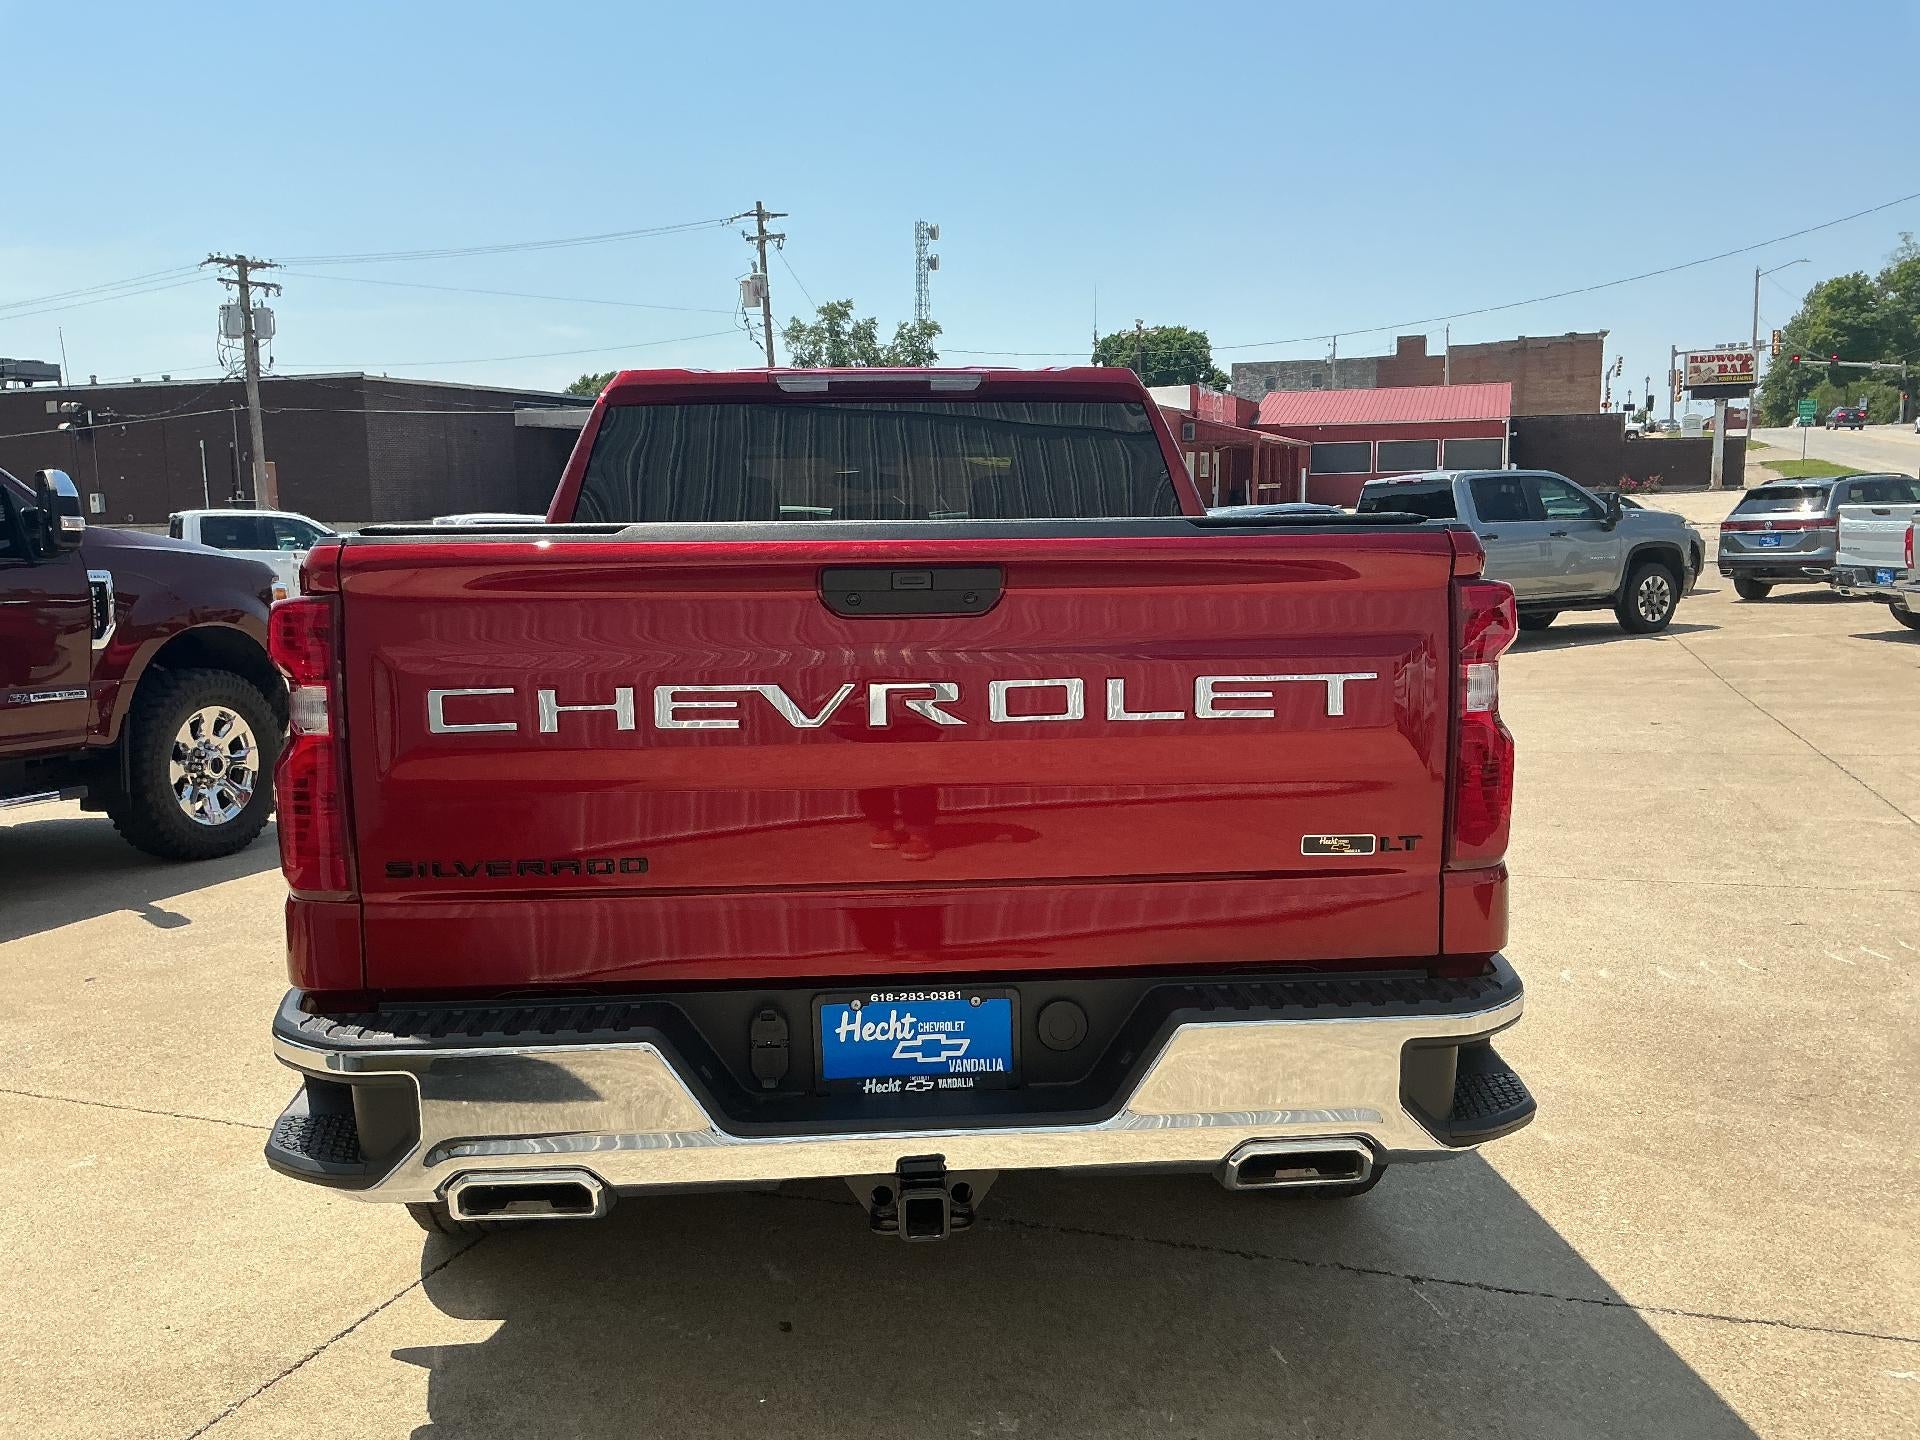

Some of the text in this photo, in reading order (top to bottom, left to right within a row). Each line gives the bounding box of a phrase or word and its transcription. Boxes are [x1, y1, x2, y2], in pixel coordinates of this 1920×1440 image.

[1690, 353, 1754, 363] REDWOOD
[1717, 363, 1754, 374] BAR
[427, 672, 1377, 735] CHEVROLET
[1380, 835, 1423, 851] LT
[385, 857, 649, 878] SILVERADO
[870, 990, 962, 1002] 618-283-0381
[835, 1009, 966, 1043] Hecht CHEVROLET
[948, 1057, 1004, 1073] VANDALIA
[863, 1077, 974, 1094] Hecht VANDALIA
